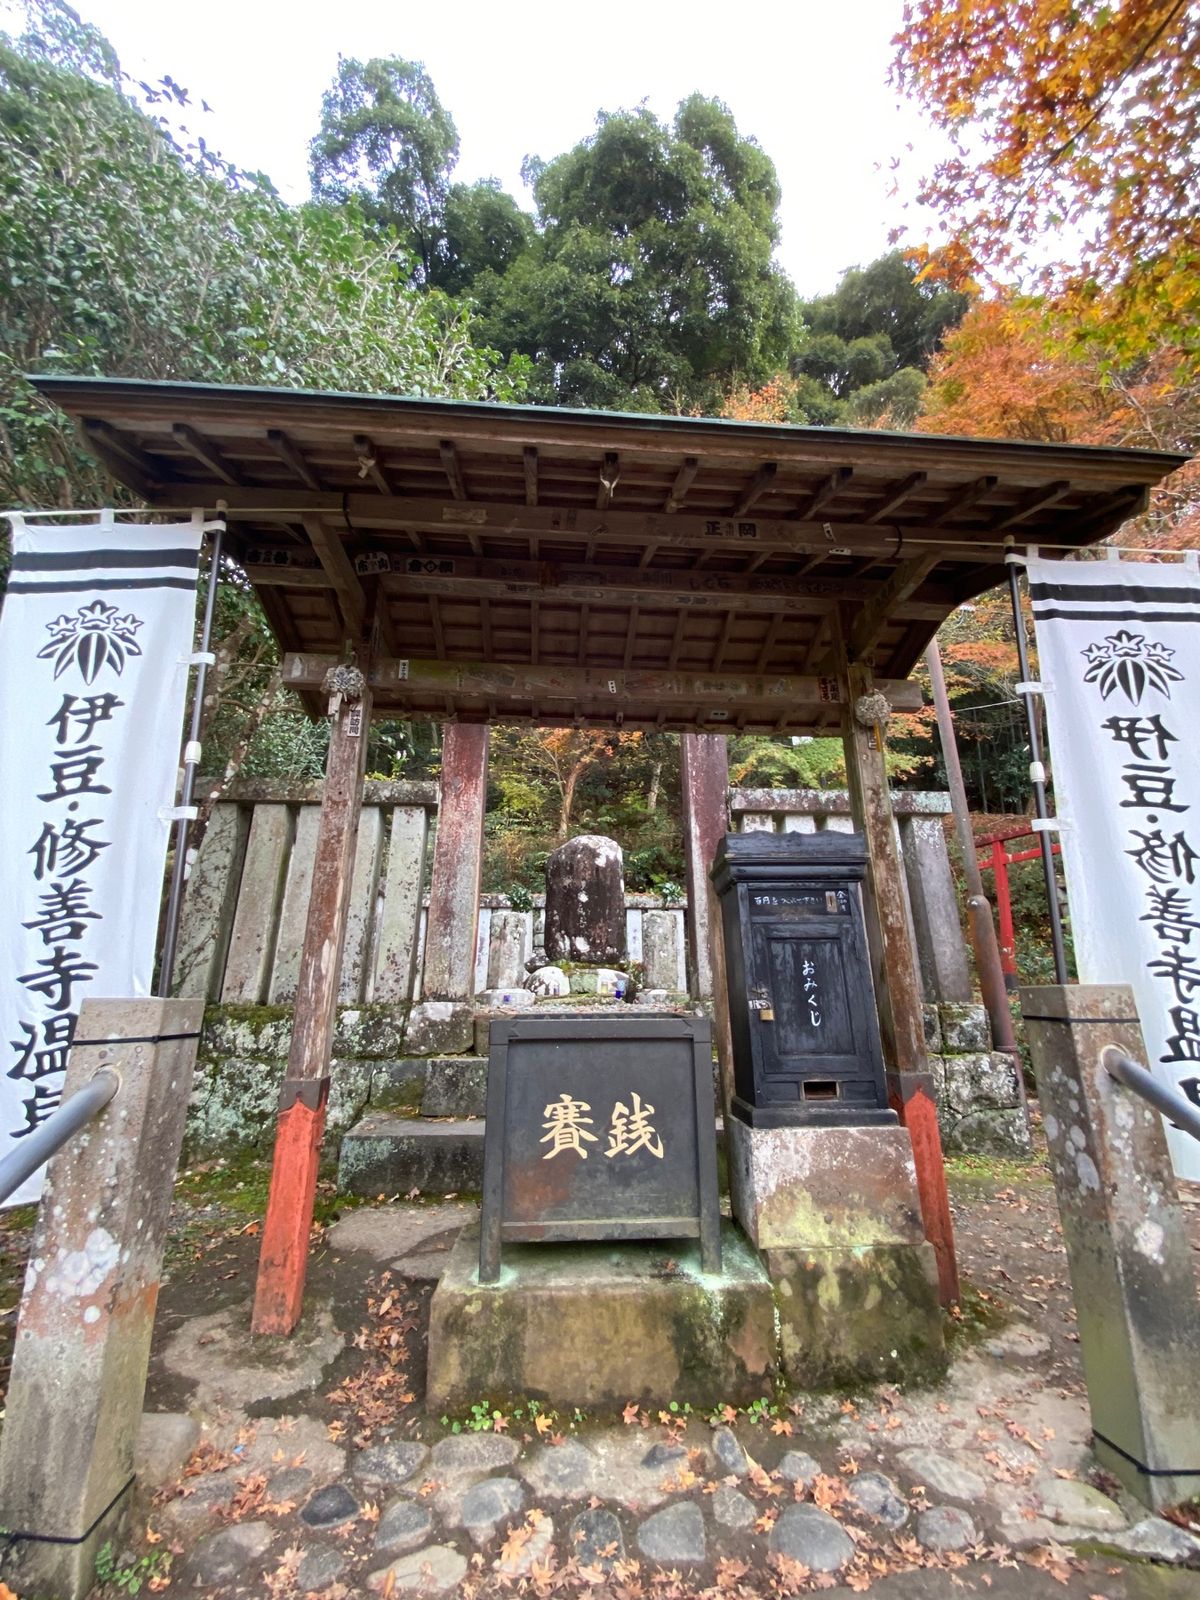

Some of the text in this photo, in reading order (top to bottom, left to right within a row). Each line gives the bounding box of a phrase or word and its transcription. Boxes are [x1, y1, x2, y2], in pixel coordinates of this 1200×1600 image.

[802, 960, 822, 1027] おみくじ
[539, 1091, 664, 1160] 賽銭
